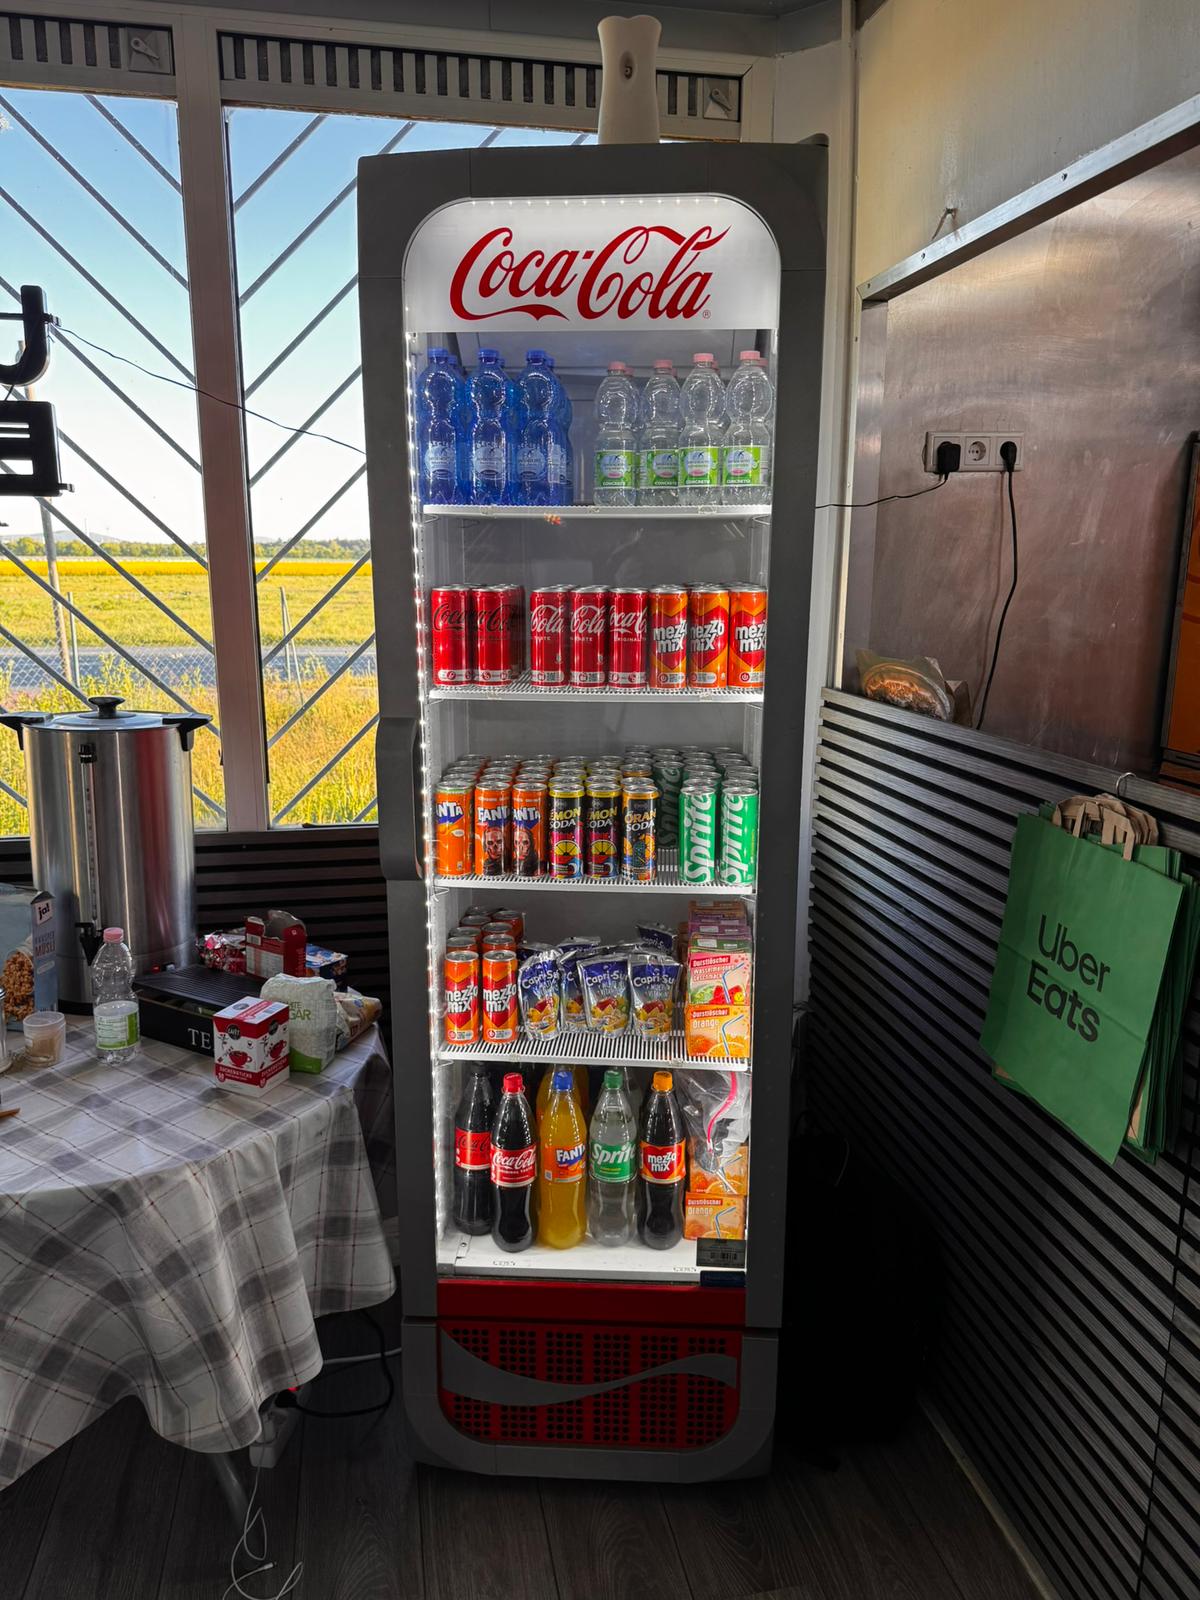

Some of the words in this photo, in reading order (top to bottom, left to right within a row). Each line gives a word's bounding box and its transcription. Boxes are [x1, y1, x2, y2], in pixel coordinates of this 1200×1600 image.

[450, 225, 732, 322] Coca-Cola
[657, 633, 684, 653] mix
[437, 801, 463, 818] NTA
[477, 805, 510, 822] FANT
[626, 820, 655, 832] SODA
[683, 793, 715, 884] Sprite
[38, 902, 50, 920] ja!
[1036, 914, 1111, 993] Uber
[445, 984, 479, 1002] mezzo
[483, 983, 517, 1002] mezzo
[1026, 959, 1101, 1043] Eats
[448, 996, 471, 1013] mix
[486, 994, 511, 1012] mix
[692, 1019, 719, 1028] Orange
[592, 1141, 636, 1166] Sprite
[647, 1151, 677, 1164] mezzo
[651, 1159, 671, 1172] mix
